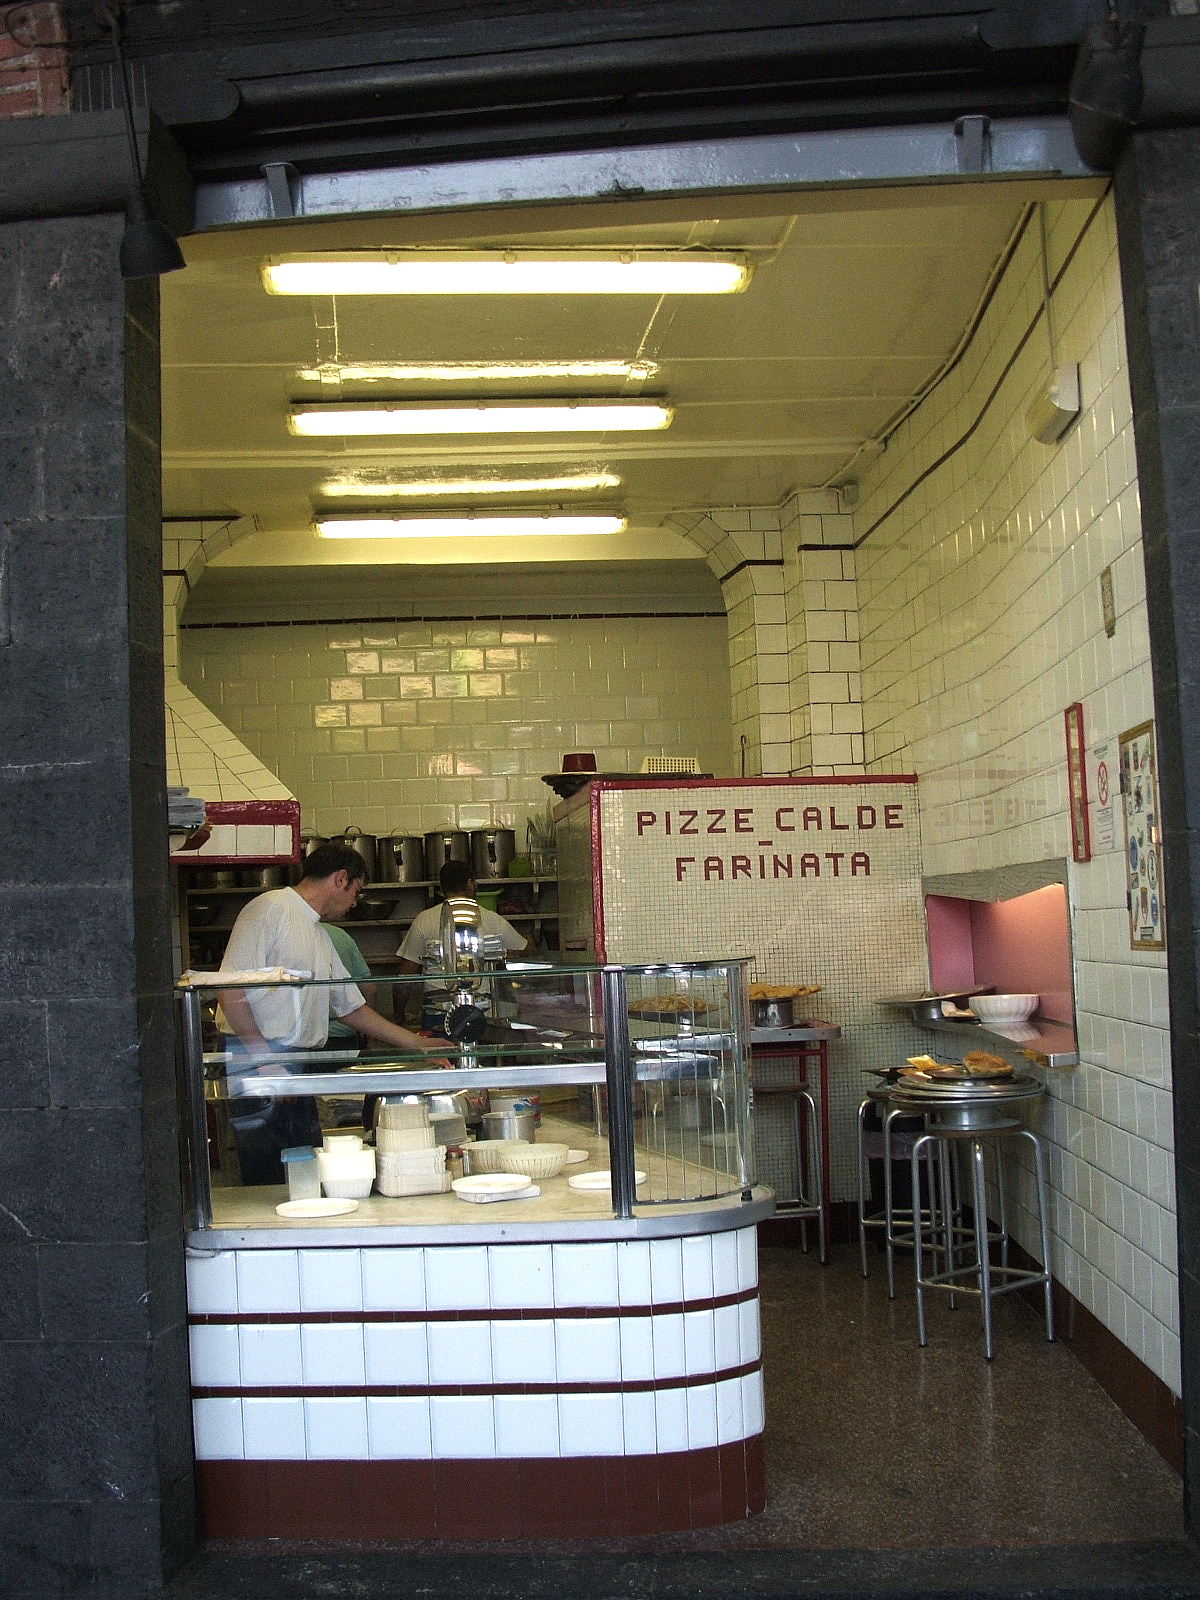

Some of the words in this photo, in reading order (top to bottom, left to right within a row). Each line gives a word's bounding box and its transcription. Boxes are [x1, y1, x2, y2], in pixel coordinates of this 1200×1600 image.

[637, 808, 754, 835] PIZZE
[775, 804, 904, 832] CALDE
[676, 852, 871, 881] FARINATA
